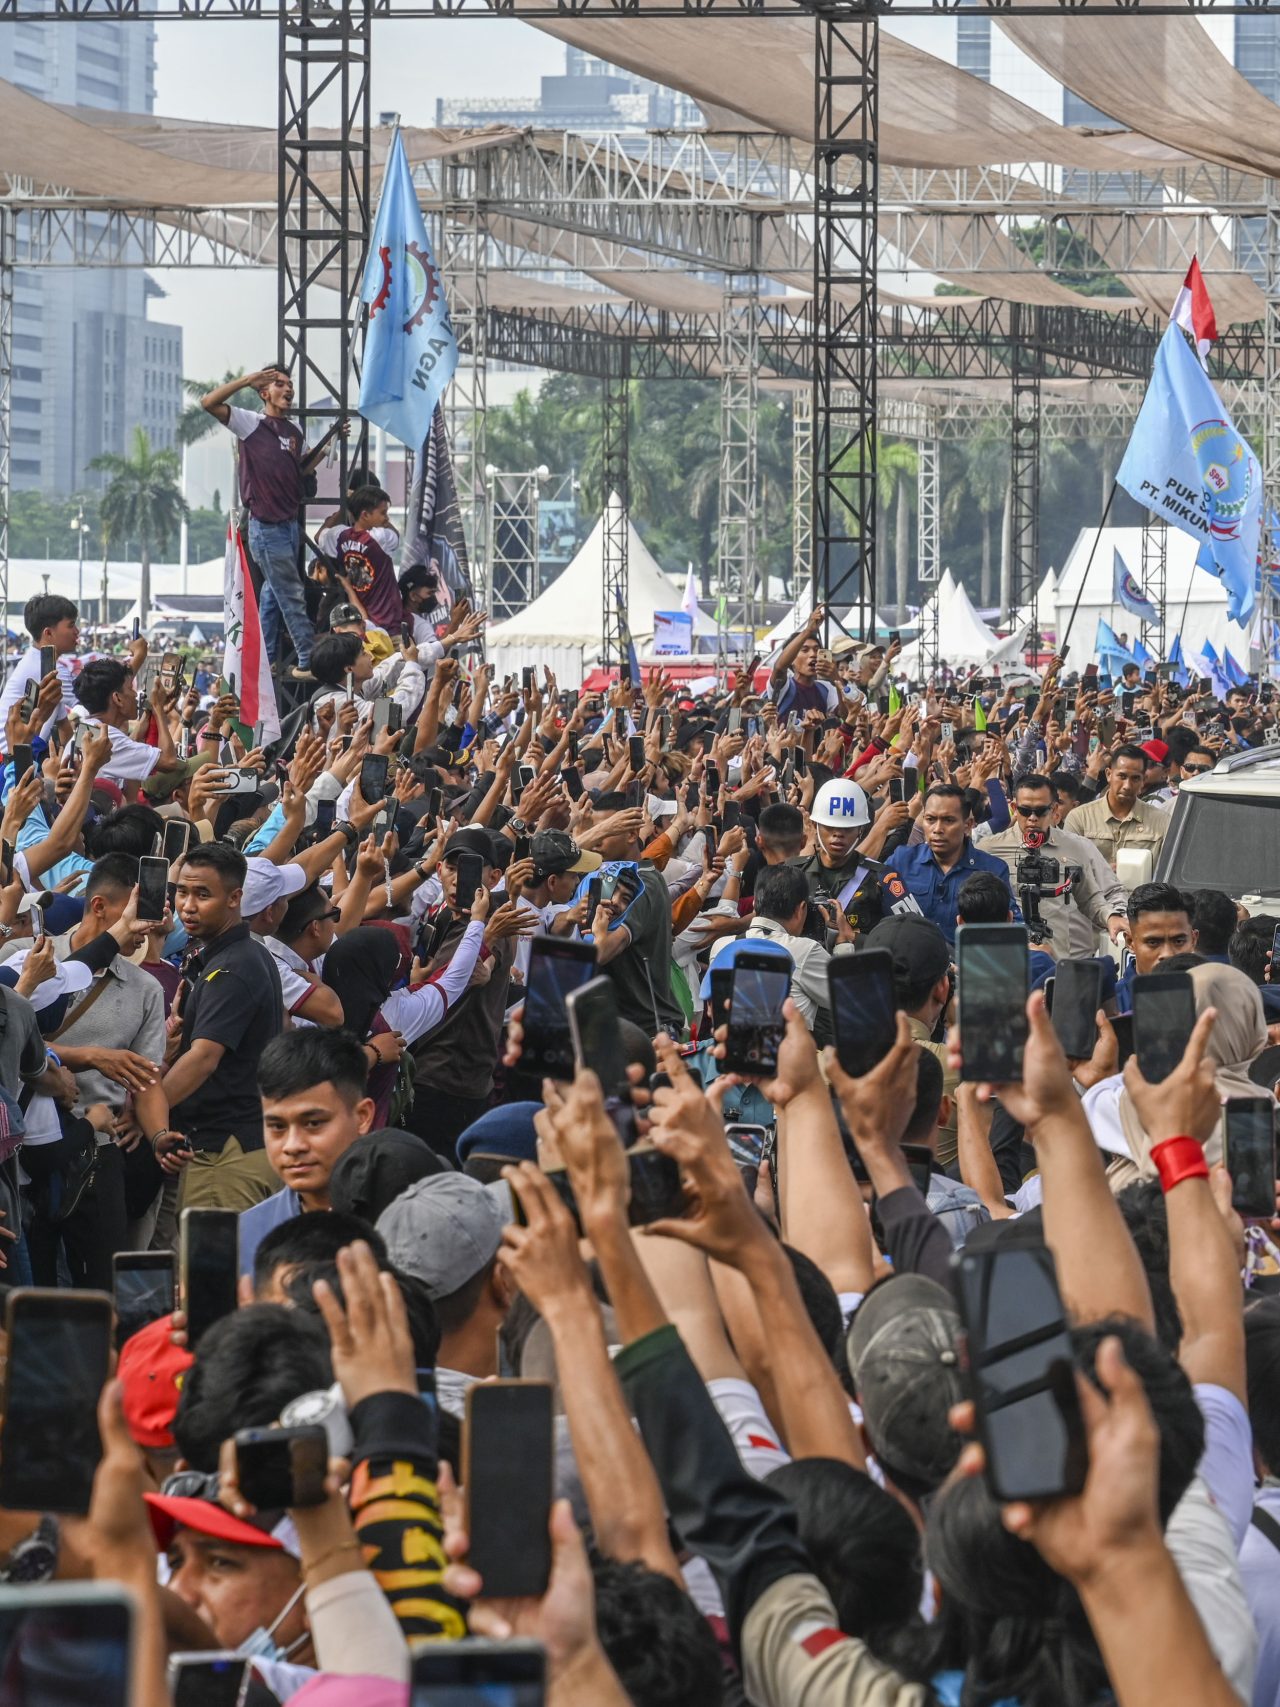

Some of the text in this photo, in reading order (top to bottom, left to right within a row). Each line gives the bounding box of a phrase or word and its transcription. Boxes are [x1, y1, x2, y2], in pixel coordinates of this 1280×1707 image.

[1165, 477, 1198, 506] PUK
[1208, 467, 1225, 490] SPSI
[1140, 480, 1210, 535] PT. MIKUN
[829, 797, 855, 817] PM
